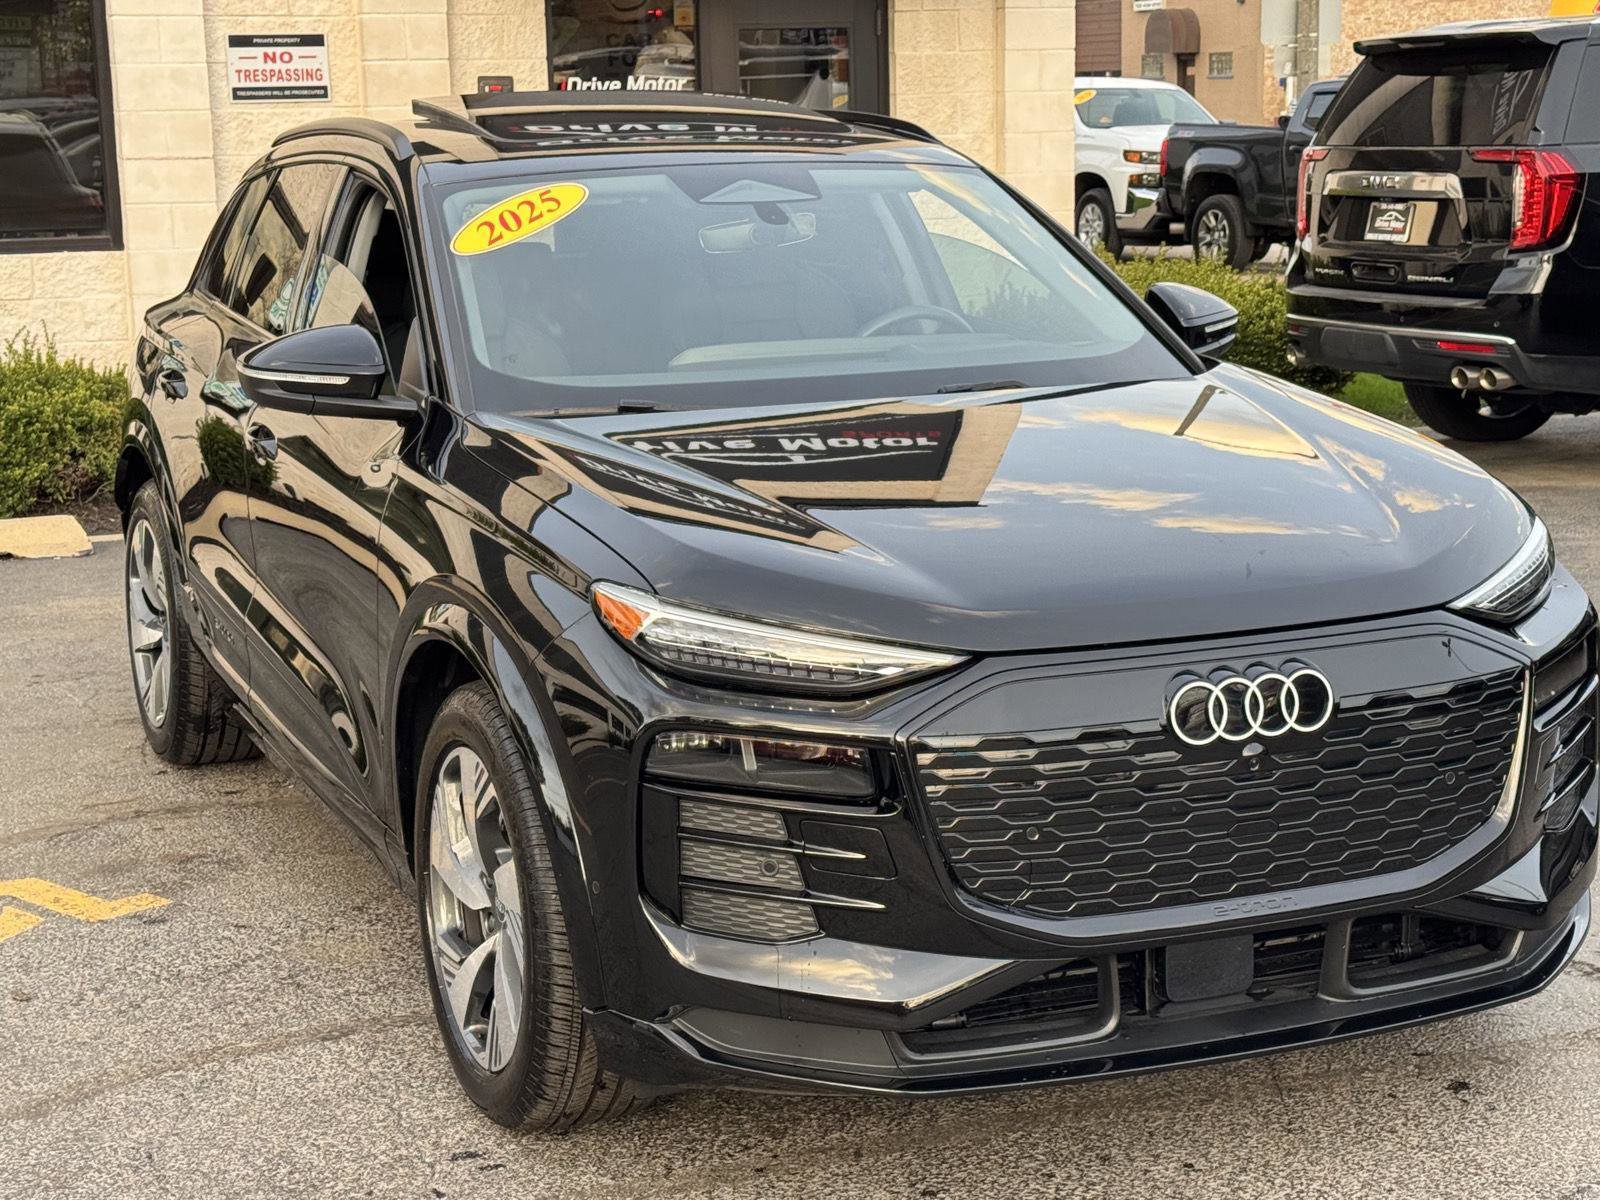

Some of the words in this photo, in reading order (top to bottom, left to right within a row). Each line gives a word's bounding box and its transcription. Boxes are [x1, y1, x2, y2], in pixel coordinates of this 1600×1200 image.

[263, 51, 293, 64] NO
[235, 68, 324, 83] TRESPASSING
[627, 75, 689, 91] Motor
[476, 189, 562, 247] 2025
[1407, 275, 1455, 283] DENALI
